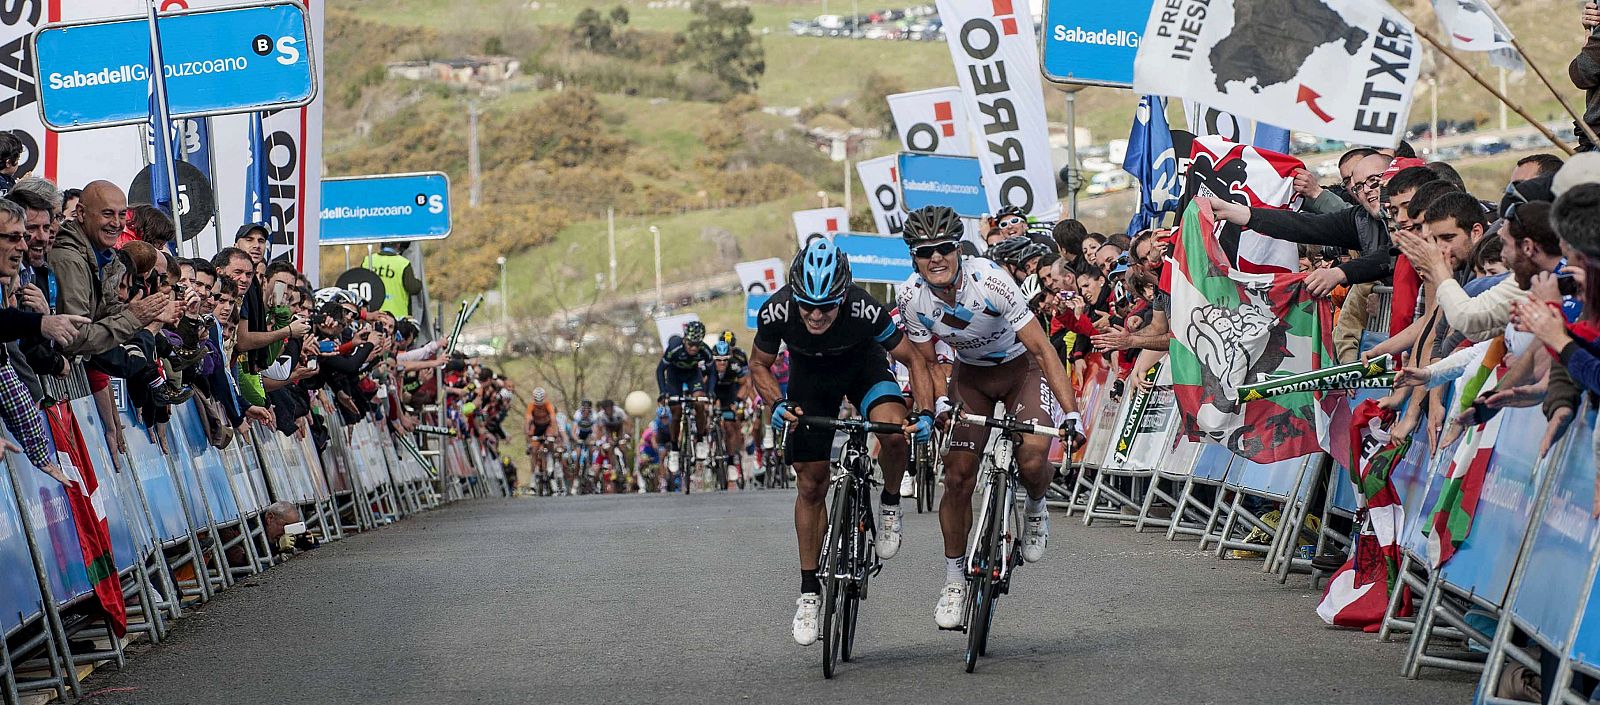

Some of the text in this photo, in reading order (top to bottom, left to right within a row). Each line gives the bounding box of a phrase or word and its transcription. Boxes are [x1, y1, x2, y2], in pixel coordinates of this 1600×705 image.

[984, 282, 1018, 308] MONDIALE
[1266, 370, 1363, 396] CAJA RURAL
